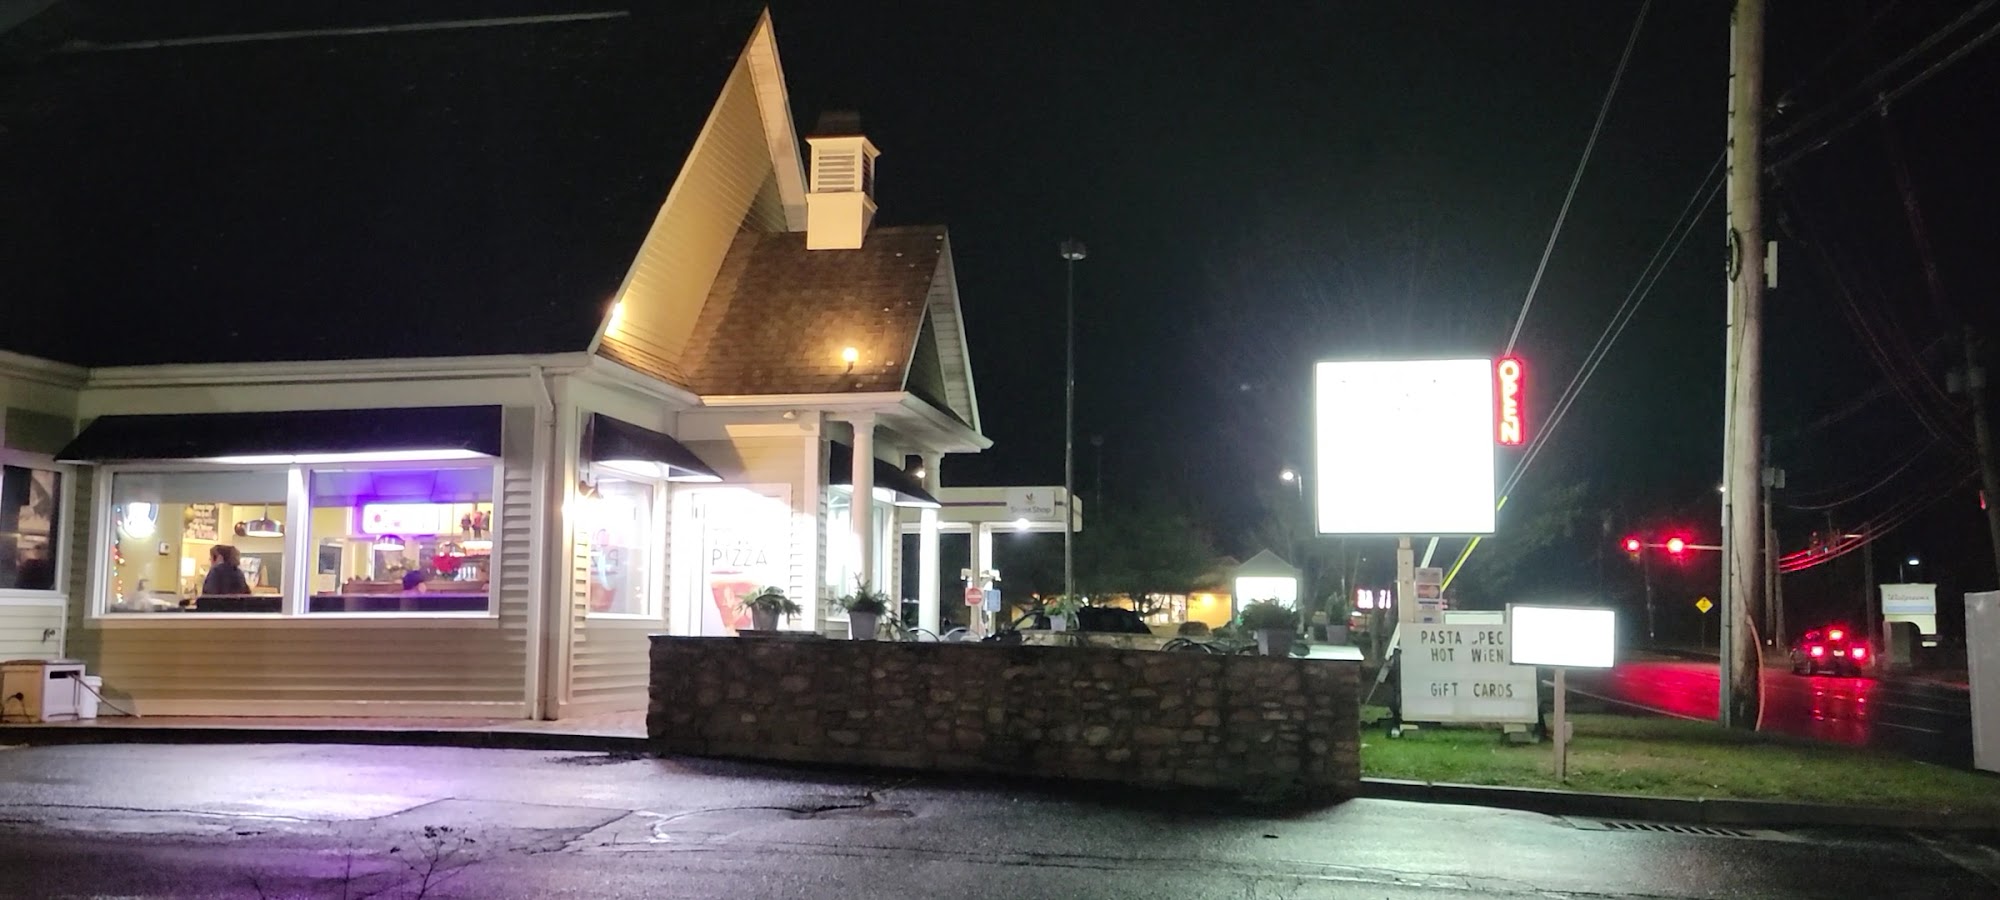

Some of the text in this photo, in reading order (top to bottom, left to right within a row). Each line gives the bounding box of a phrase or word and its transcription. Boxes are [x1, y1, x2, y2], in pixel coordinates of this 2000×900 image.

[1499, 360, 1521, 443] OPEN
[711, 547, 768, 567] PIZZA
[1420, 630, 1462, 645] PASTA
[1430, 647, 1455, 662] HOT
[1473, 682, 1513, 698] CARDS
